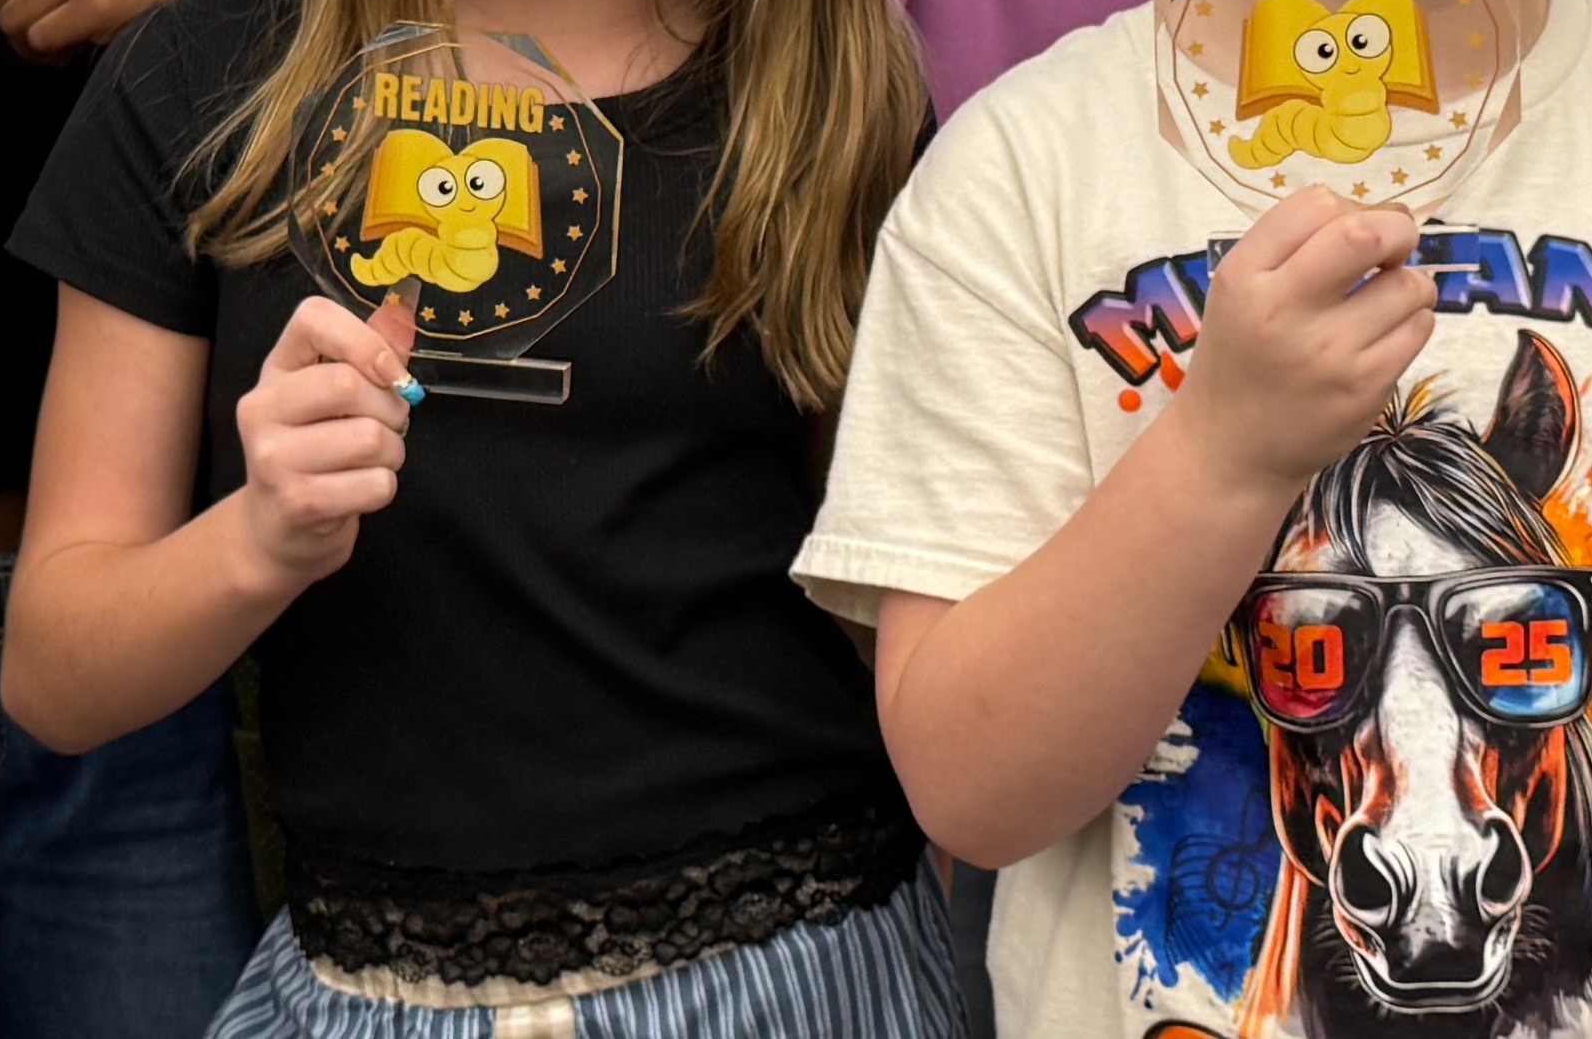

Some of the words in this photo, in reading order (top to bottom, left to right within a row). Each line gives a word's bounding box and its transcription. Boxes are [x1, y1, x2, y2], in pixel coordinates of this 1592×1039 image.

[373, 72, 545, 134] READING
[1259, 621, 1344, 690] 20
[1481, 618, 1572, 687] 25
